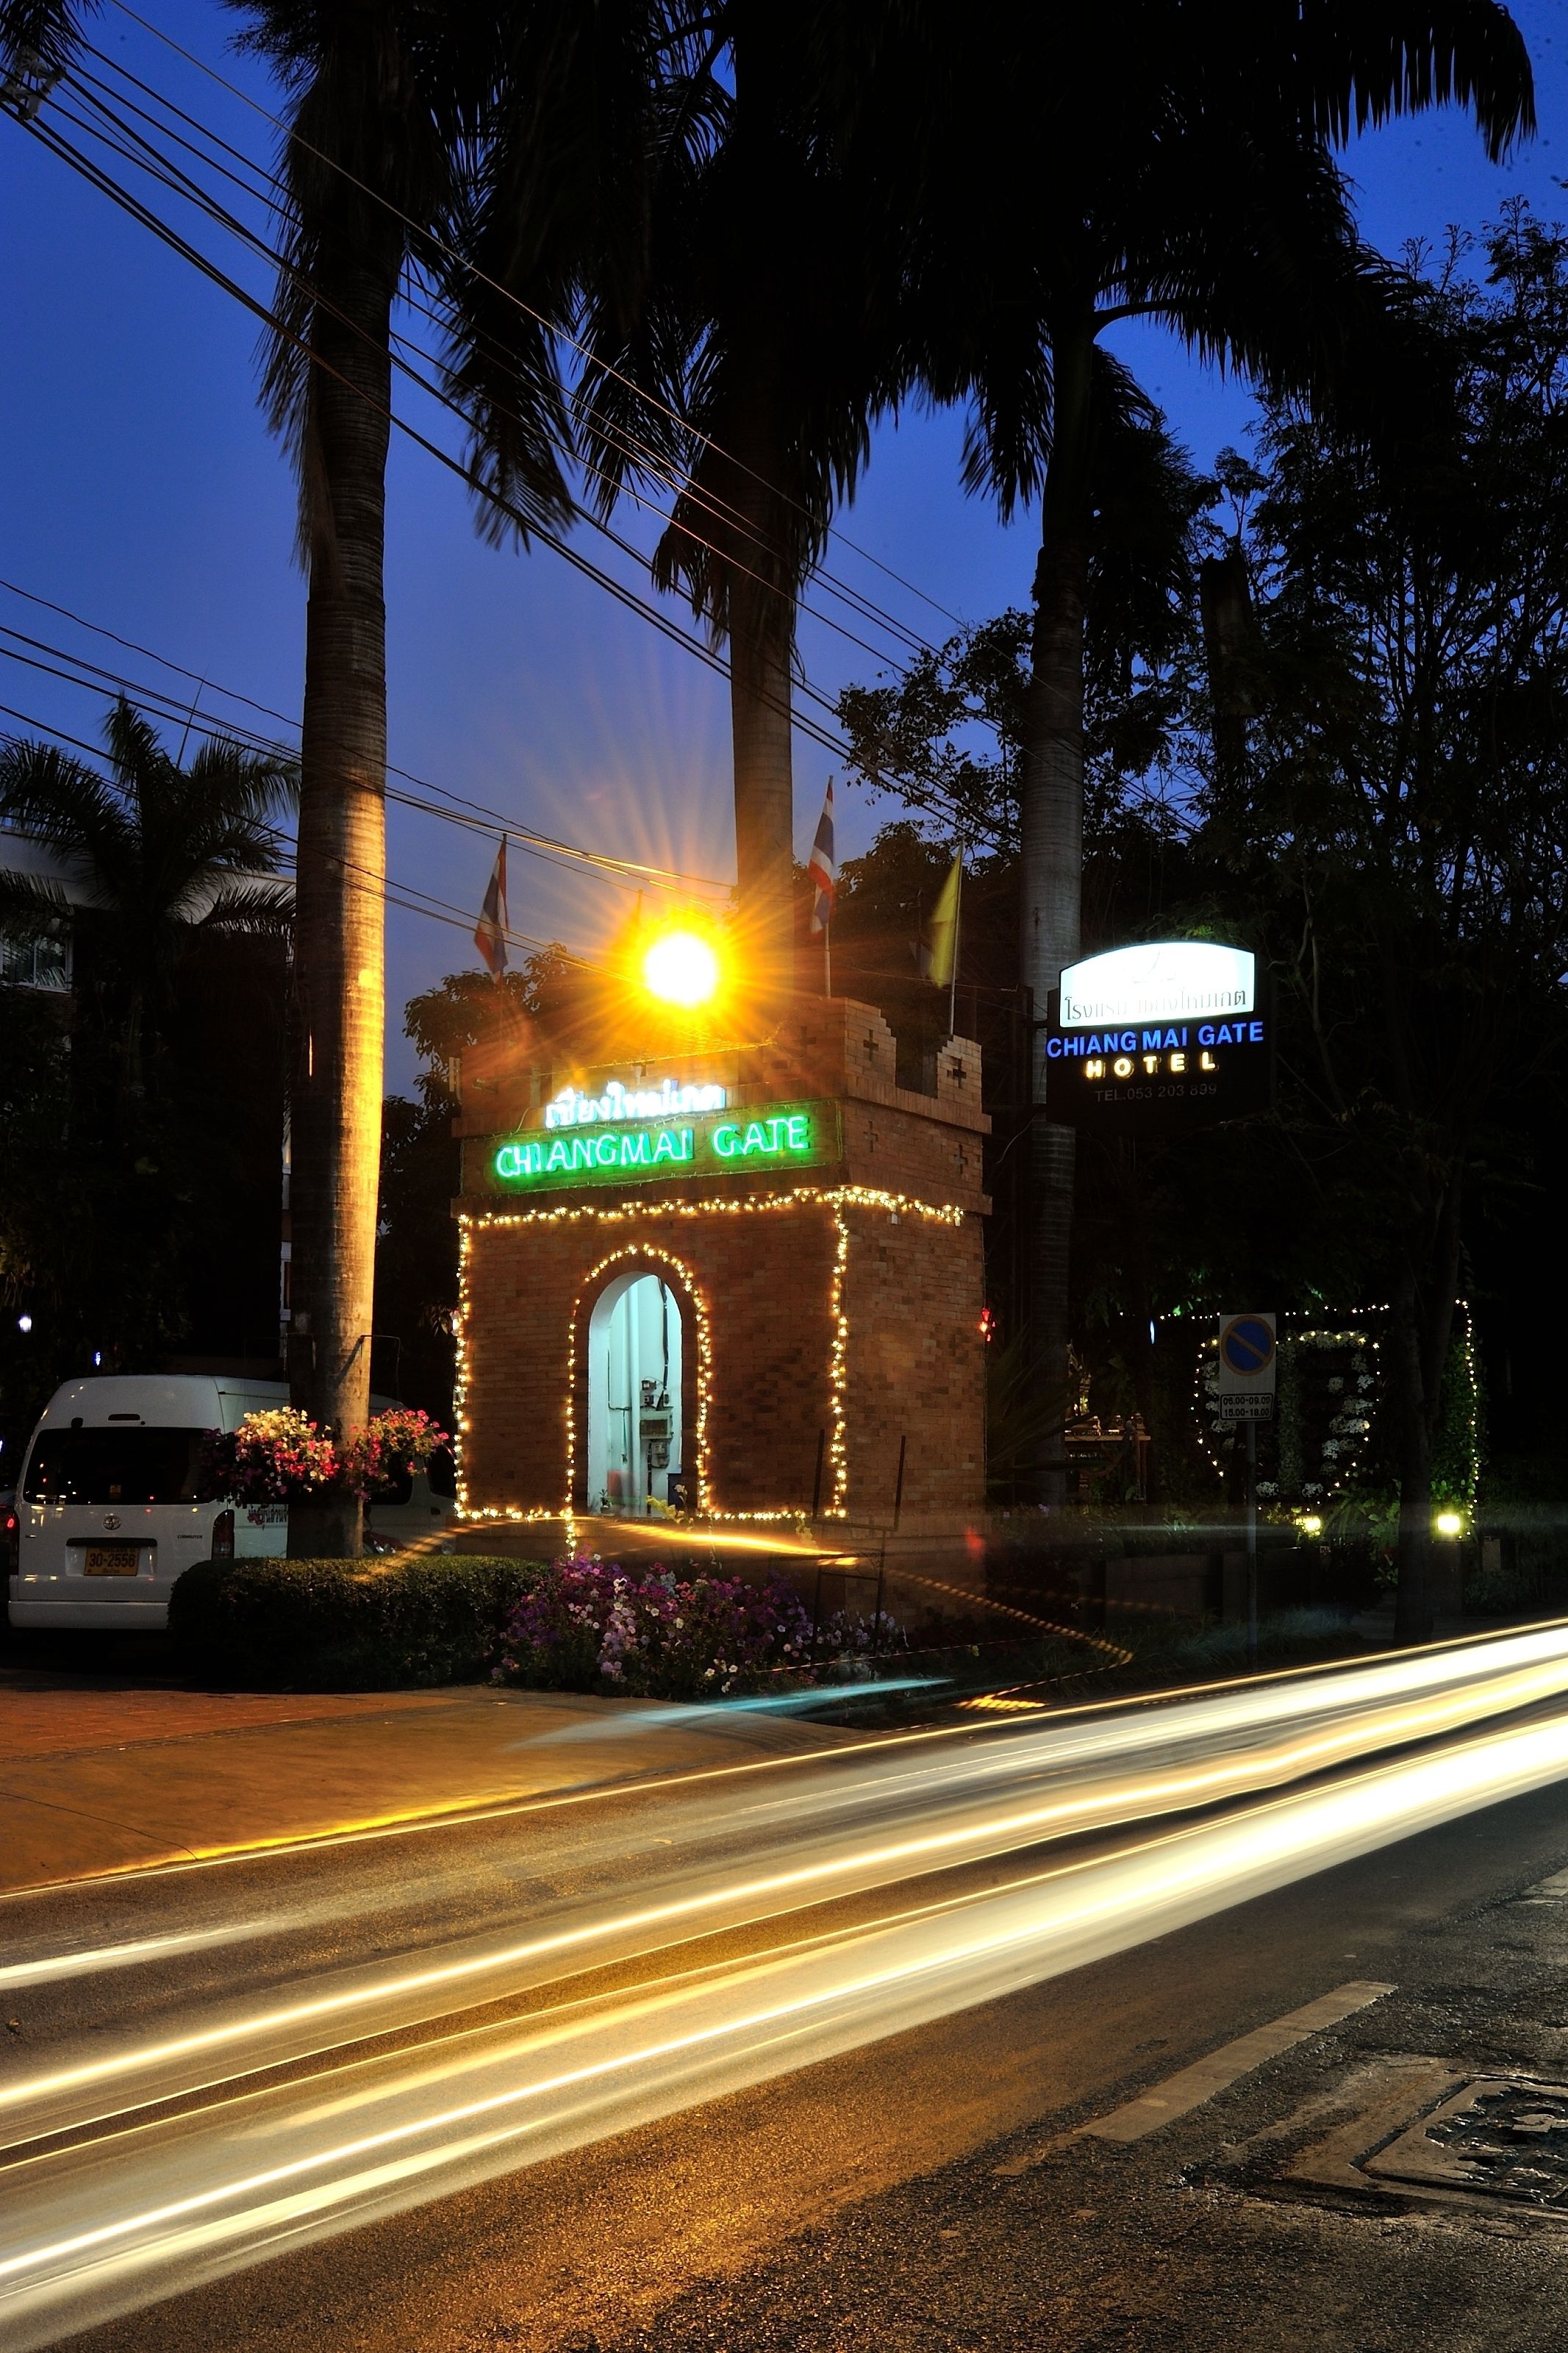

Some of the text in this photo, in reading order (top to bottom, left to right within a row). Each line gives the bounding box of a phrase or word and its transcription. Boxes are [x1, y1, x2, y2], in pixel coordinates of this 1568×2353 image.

[1046, 1021, 1264, 1058] CHIANG MAI GATE
[1085, 1051, 1217, 1079] HOTEL
[1095, 1088, 1153, 1103] TEL.053
[1158, 1084, 1184, 1098] 203
[495, 1115, 810, 1178] CHIANGMAI GATE
[1222, 1396, 1271, 1405] 06.00-09.00
[1224, 1407, 1270, 1417] 15.00-18.00
